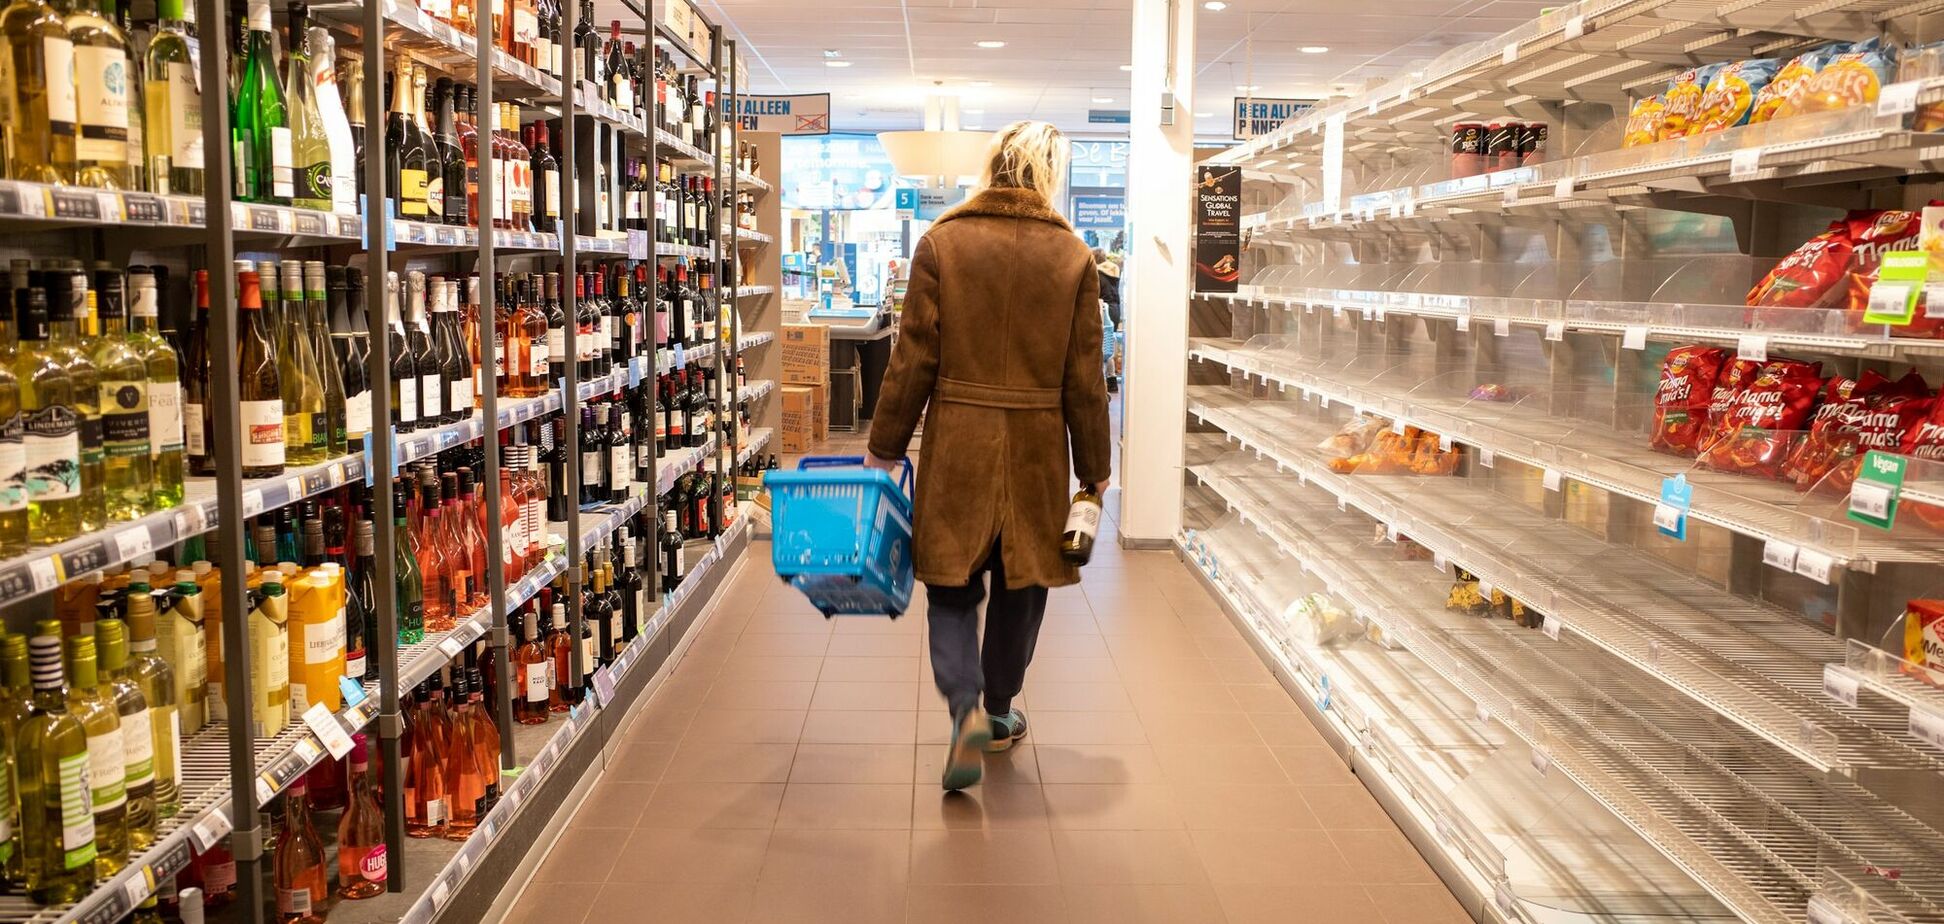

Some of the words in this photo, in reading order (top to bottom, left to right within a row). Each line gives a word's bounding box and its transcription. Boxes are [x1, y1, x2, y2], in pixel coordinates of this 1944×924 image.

[744, 100, 791, 115] ALLEEN
[1239, 102, 1267, 118] HER
[901, 192, 909, 205] 5
[1200, 194, 1238, 202] SENSATIONS
[1205, 202, 1233, 210] GLOBAL
[1207, 209, 1231, 217] TRAVEL
[39, 323, 48, 338] L
[52, 408, 61, 422] L
[1872, 454, 1900, 474] Vegan
